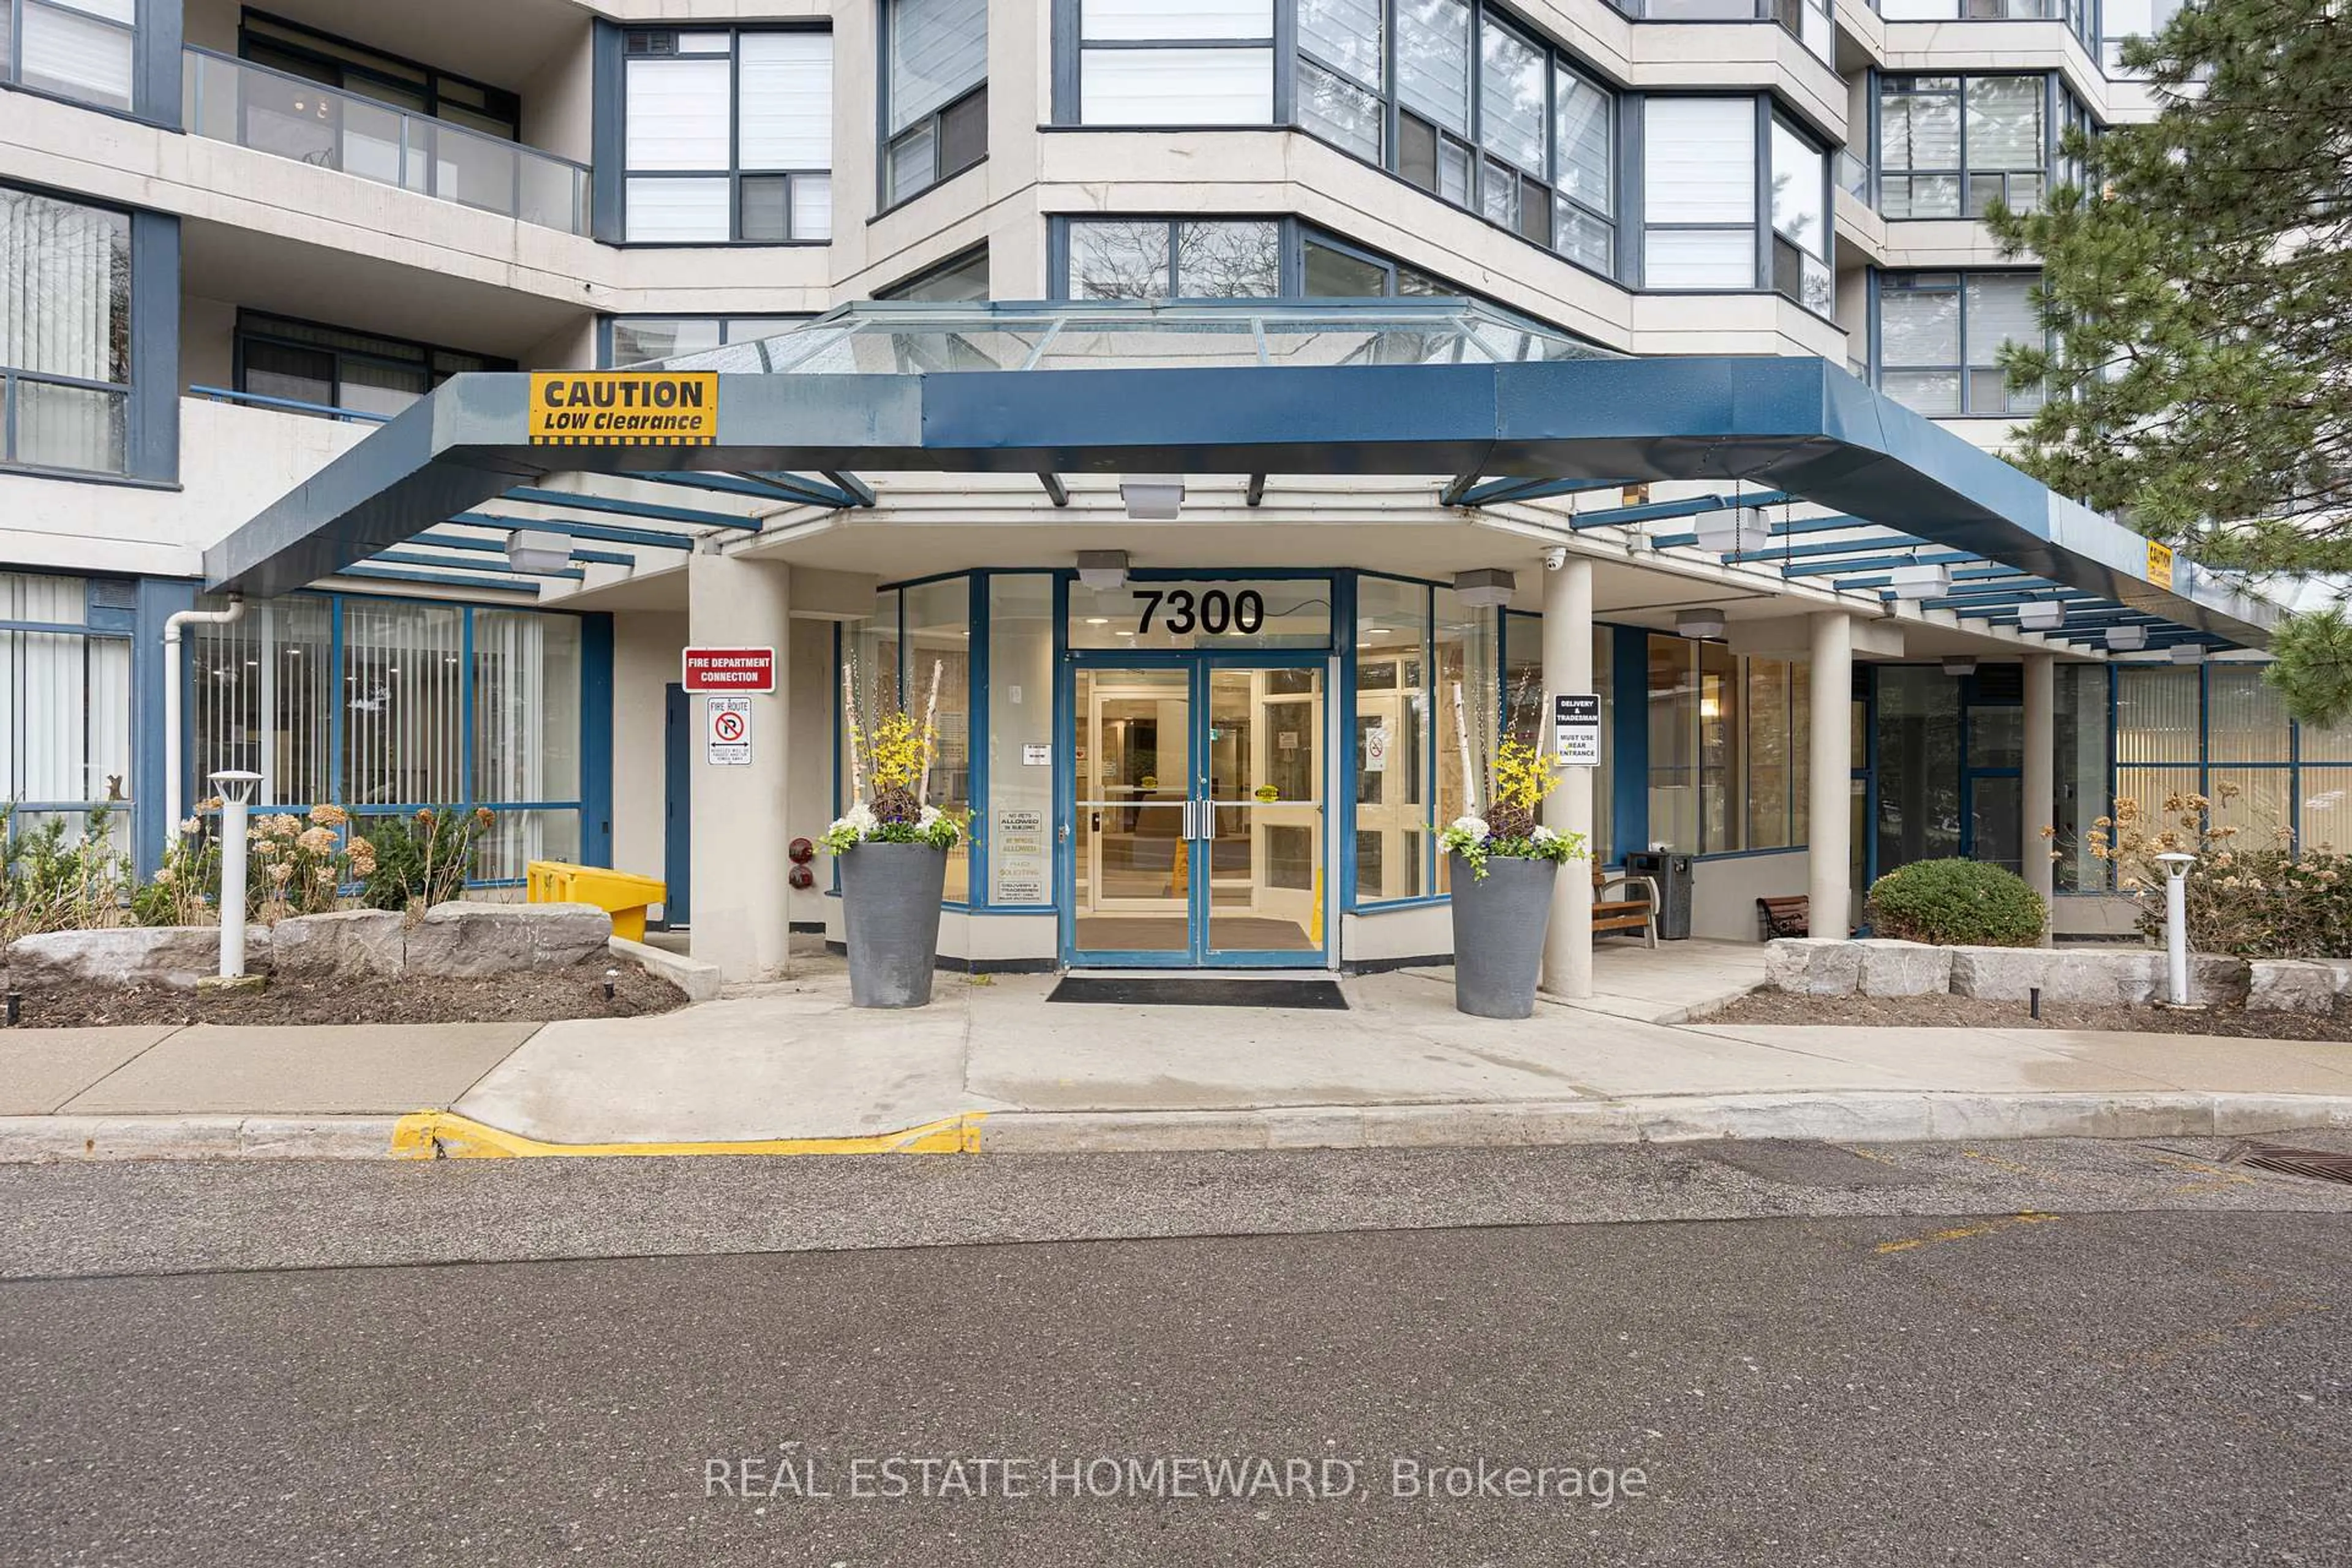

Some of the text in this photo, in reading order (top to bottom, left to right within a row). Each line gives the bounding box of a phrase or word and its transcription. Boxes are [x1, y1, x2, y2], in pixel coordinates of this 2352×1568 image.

[544, 381, 703, 408] CAUTION
[544, 412, 703, 430] LOW Clearance
[1133, 589, 1264, 635] 7300
[688, 658, 771, 668] FIRE DEPARTMENT
[701, 672, 758, 682] CONNECTION
[710, 702, 748, 712] FIRE ROUTE
